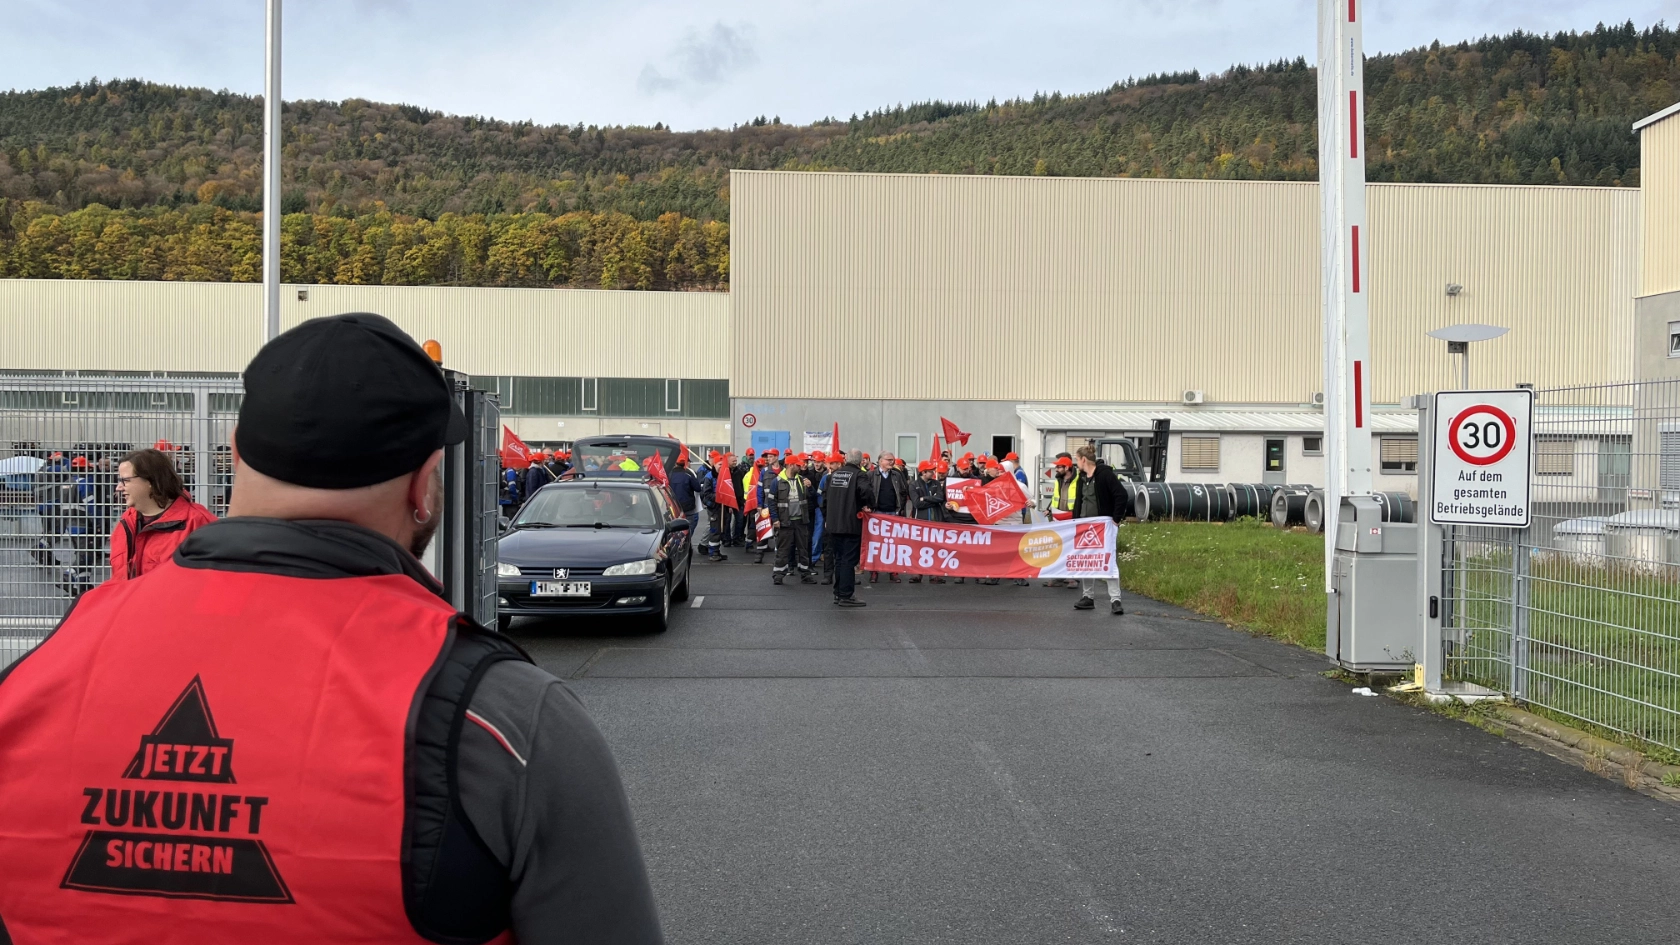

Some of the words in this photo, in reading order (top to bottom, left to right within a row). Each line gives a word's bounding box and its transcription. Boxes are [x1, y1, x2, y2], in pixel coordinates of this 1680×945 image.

[1462, 421, 1501, 449] 30
[1457, 470, 1477, 482] Auf
[1480, 470, 1503, 483] dem
[1453, 487, 1507, 502] gesamten
[1436, 501, 1524, 518] Betriebsgelände
[867, 517, 991, 545] GEMEINSAM
[1028, 536, 1053, 545] DAFÜR
[867, 539, 912, 567] FÜR
[1032, 550, 1050, 559] WIR!
[140, 742, 229, 778] JETZT
[80, 786, 269, 835] ZUKUNFT
[105, 839, 234, 875] SICHERN
